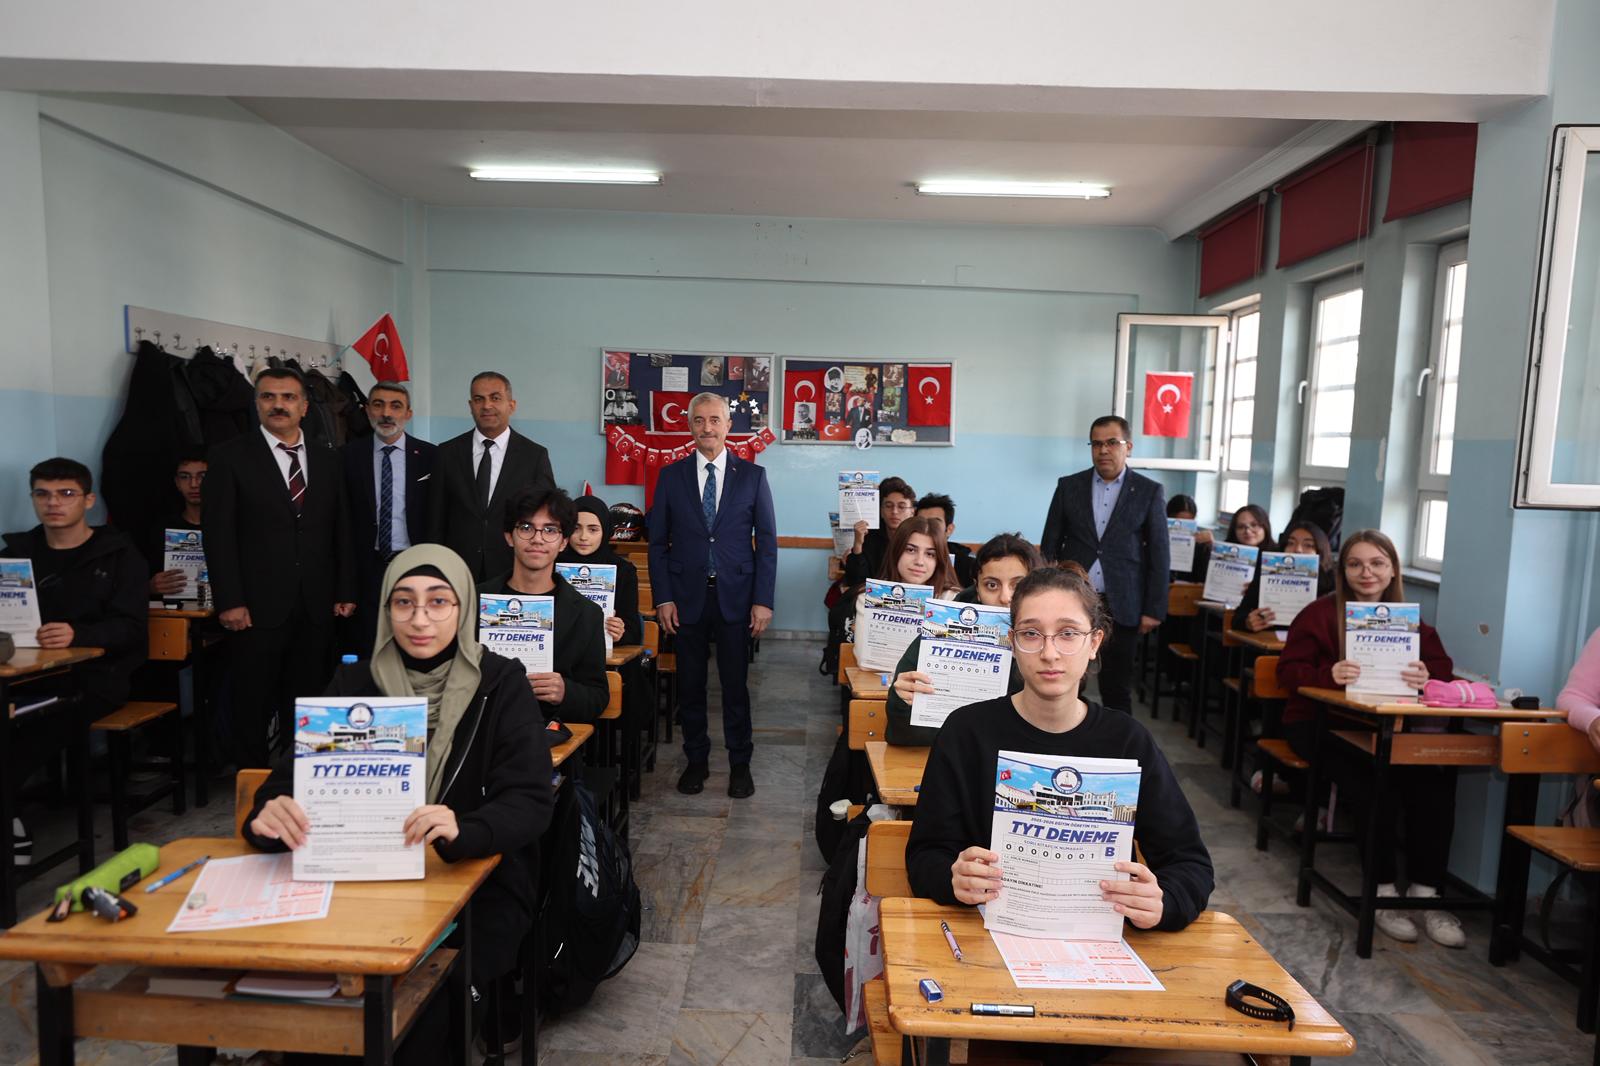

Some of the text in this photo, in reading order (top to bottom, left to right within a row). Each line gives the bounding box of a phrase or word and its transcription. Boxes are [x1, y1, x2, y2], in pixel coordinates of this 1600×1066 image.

[872, 613, 888, 621] TYT
[888, 615, 923, 626] DENEME
[506, 633, 544, 642] DENEME
[932, 646, 953, 657] TYT
[954, 650, 1002, 663] DENEME
[313, 764, 412, 777] TYT DENEME
[401, 781, 409, 791] B
[1012, 821, 1119, 843] TYT DENEME
[1105, 847, 1115, 857] B
